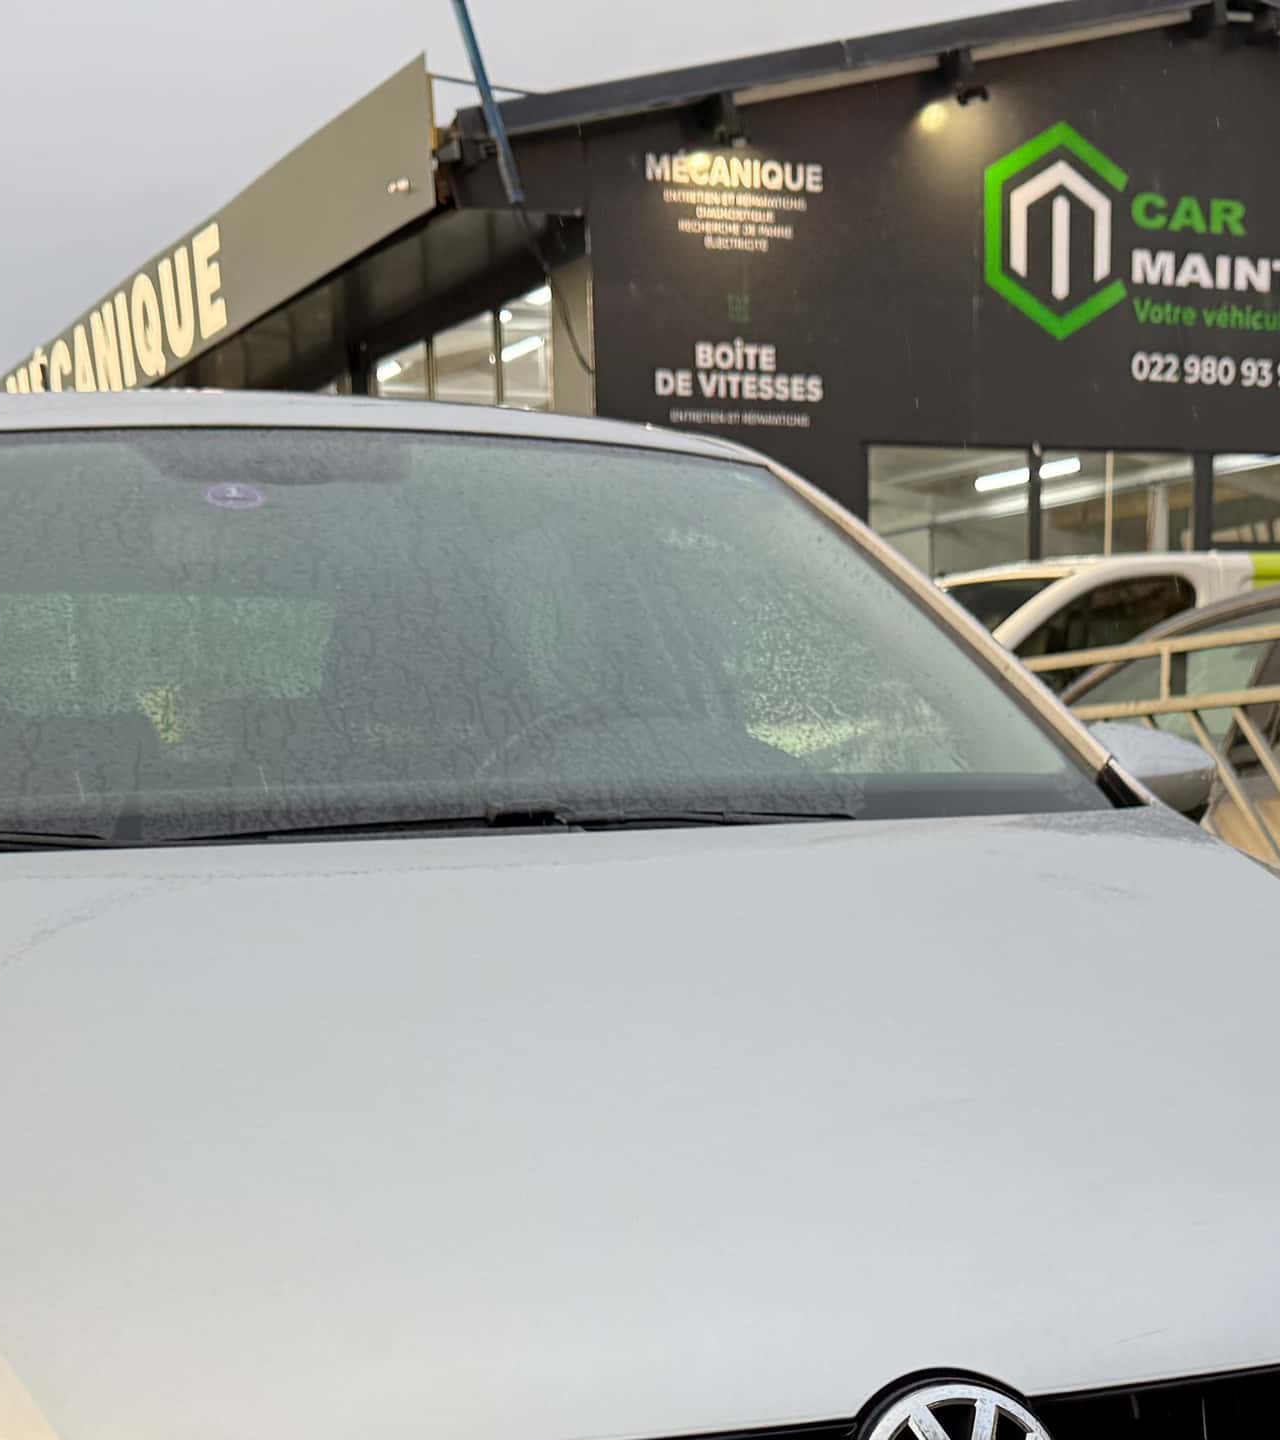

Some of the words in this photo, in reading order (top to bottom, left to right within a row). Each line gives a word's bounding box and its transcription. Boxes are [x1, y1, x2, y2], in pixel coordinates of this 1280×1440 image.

[645, 150, 823, 192] MÉCANIQUE
[1131, 192, 1246, 236] CAR
[1133, 298, 1197, 327] Votre
[695, 337, 776, 372] BOÎTE
[1131, 351, 1180, 383] 022
[1183, 354, 1236, 386] 980
[1240, 357, 1273, 388] 93
[655, 369, 693, 397] DE
[698, 371, 823, 402] VITESSES
